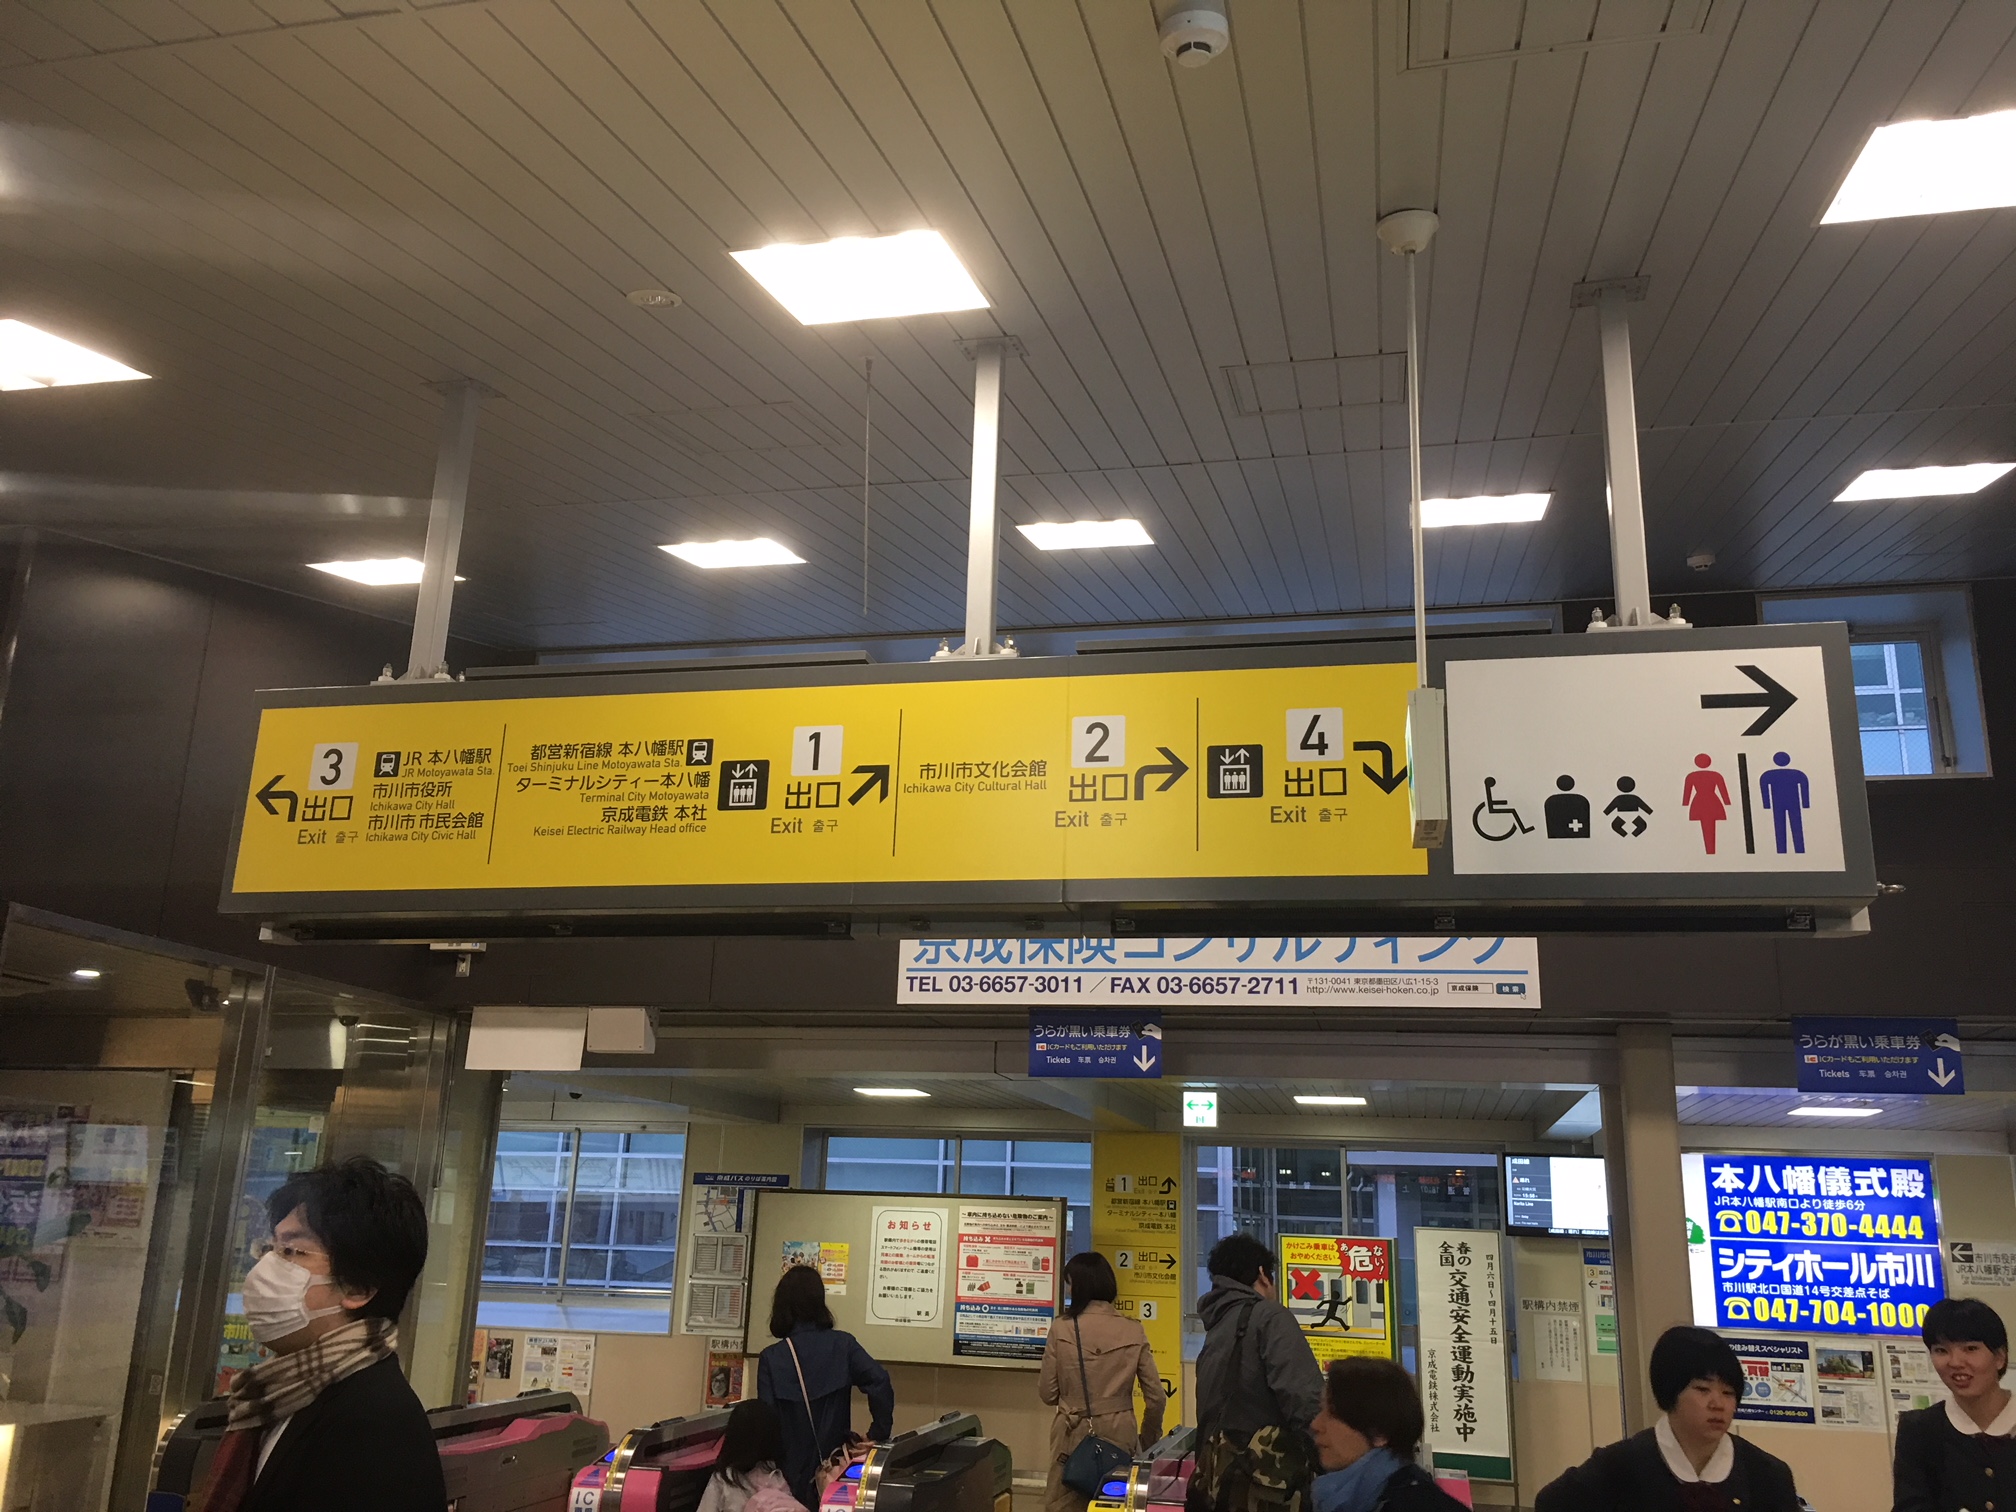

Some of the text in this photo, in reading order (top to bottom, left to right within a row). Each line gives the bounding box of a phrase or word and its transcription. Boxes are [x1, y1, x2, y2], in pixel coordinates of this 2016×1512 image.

[1084, 721, 1110, 763] 2
[1300, 714, 1329, 756] 4
[402, 748, 492, 766] JR 本八幡駅
[531, 739, 685, 761] 都営新宿線 本八幡駅
[808, 731, 821, 771] 1
[319, 748, 344, 786] 3
[400, 766, 495, 778] JR Motoyawata Sta.
[507, 757, 683, 773] Toei Shinjuku Line Motoyawata Sta.
[919, 759, 1048, 780] 市川市文化会館
[515, 770, 711, 792] ターミナルシティー本八幡
[903, 780, 1047, 794] Ichikawa City Cultural Hall
[1069, 772, 1129, 802] 出口
[1284, 767, 1348, 797] 出口
[372, 781, 453, 799] 市川市役所
[580, 790, 709, 803] Terminal City Motoyawata
[785, 780, 841, 810] 出口
[300, 794, 354, 823] 出口
[370, 800, 456, 812] Ichikawa City Hall
[601, 804, 708, 823] 京成電鉄 本社
[1270, 805, 1307, 823] Exit
[367, 812, 485, 830] 市川市 市民会館
[1054, 810, 1089, 828] Exit
[1100, 812, 1129, 827] 출구
[1318, 807, 1348, 822] 출구
[533, 821, 707, 836] Keisei Electric Railway Head office
[770, 817, 803, 834] Exit
[812, 818, 839, 833] 출구
[297, 830, 327, 845] Exit
[335, 830, 359, 844] 출구
[365, 830, 477, 842] Ichikawa City Civic Hall
[906, 976, 943, 992] TEL
[949, 976, 1083, 993] 03-6657-3011
[1110, 977, 1150, 993] FAX
[1157, 976, 1298, 995] 03-6657-2711
[1354, 977, 1439, 986] 東京都墨田区八広1-15-3
[1451, 984, 1479, 992] 京成保険
[1306, 986, 1439, 996] http://www.keisei-hoken.co.jp
[1034, 1025, 1130, 1039] うらが黒い乗車券
[1800, 1034, 1921, 1049] うらが黒い乗車券
[1046, 1055, 1071, 1064] Tickets
[1819, 1069, 1850, 1078] Tickets
[1121, 1177, 1126, 1191] 1
[1138, 1176, 1157, 1186] 出口
[1711, 1163, 1926, 1198] 本八幡儀式殿
[1714, 1196, 1865, 1211] JR本八幡駅南口より徒歩6分
[888, 1221, 931, 1230] お知らせ
[1745, 1211, 1924, 1239] 047-370-4444
[1286, 1242, 1335, 1250] かけこみ乗車は
[1439, 1241, 1455, 1267] 全国
[1456, 1242, 1472, 1266] 春の
[1120, 1253, 1128, 1267] 2
[1139, 1252, 1158, 1262] 出口
[1349, 1245, 1374, 1271] 危
[1719, 1248, 1935, 1288] シティホール市川
[1722, 1282, 1891, 1299] 市川駅北口国道14号交差点そば
[1115, 1301, 1133, 1310] 出口
[1143, 1303, 1152, 1318] 3
[1522, 1300, 1580, 1312] 駅構内禁煙
[1754, 1298, 1929, 1328] 047-704-1000
[1448, 1269, 1477, 1442] 交通安全運動実施中
[1427, 1349, 1440, 1433] 京成電鉄株式会社
[576, 1491, 594, 1505] IC
